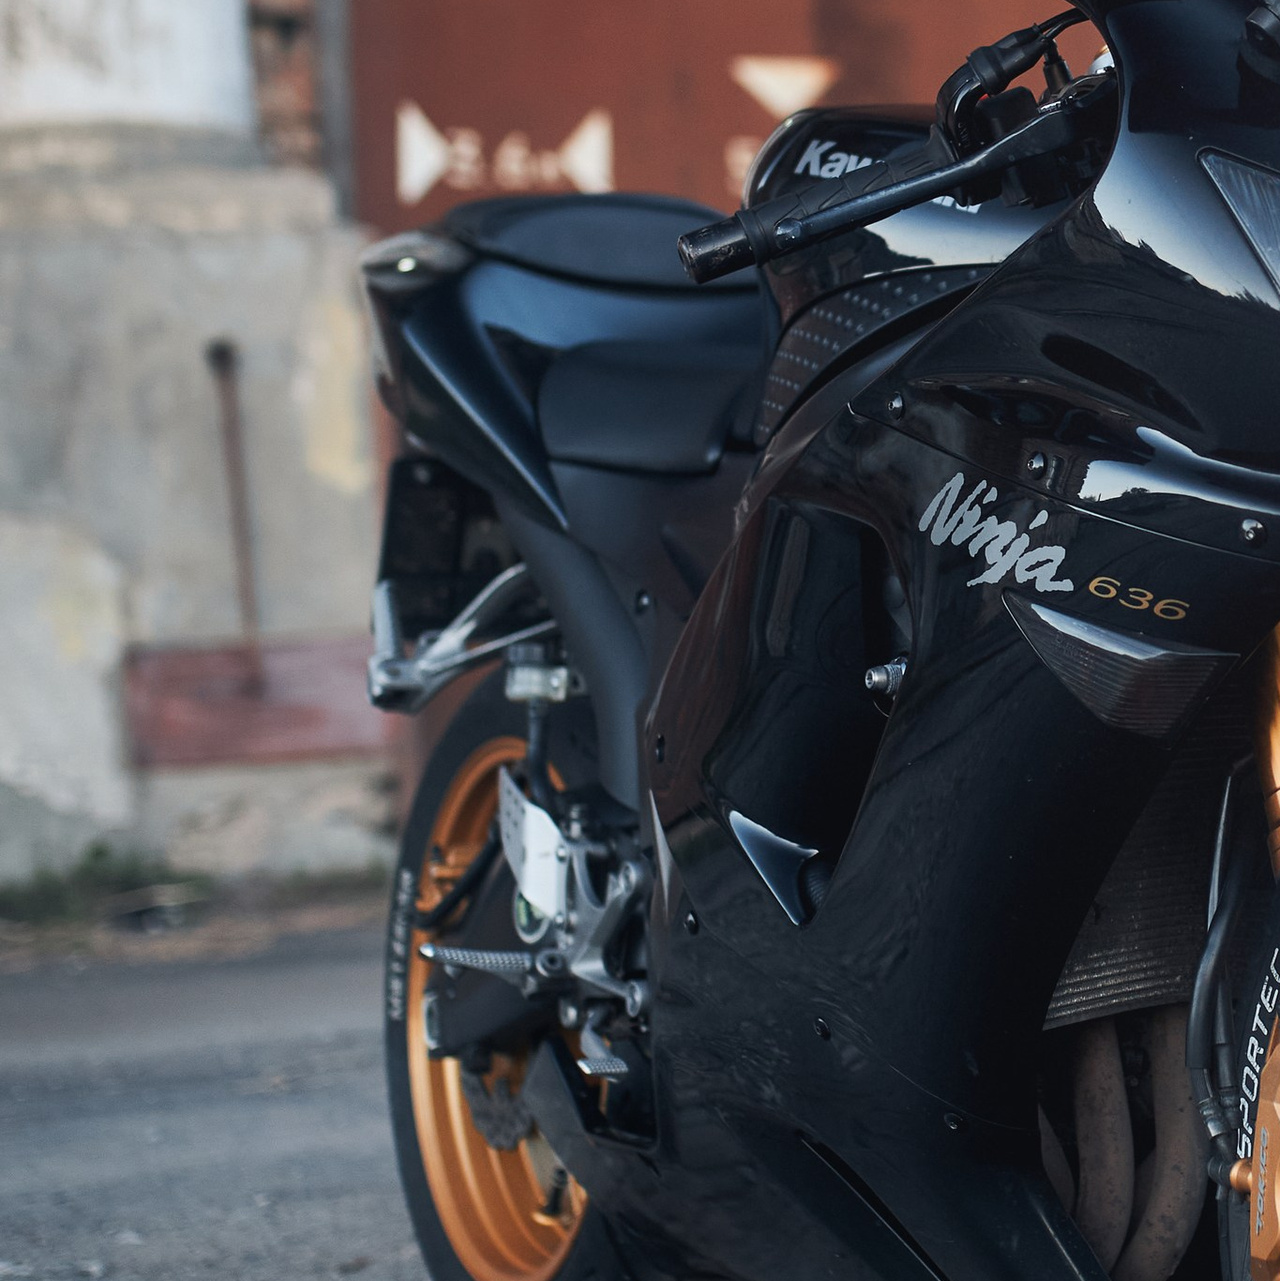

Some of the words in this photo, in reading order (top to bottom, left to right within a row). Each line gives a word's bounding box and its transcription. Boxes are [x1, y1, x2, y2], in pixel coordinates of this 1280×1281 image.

[919, 472, 1074, 592] Ninja
[1088, 576, 1190, 620] 636
[1255, 1126, 1268, 1236] TOKICO
